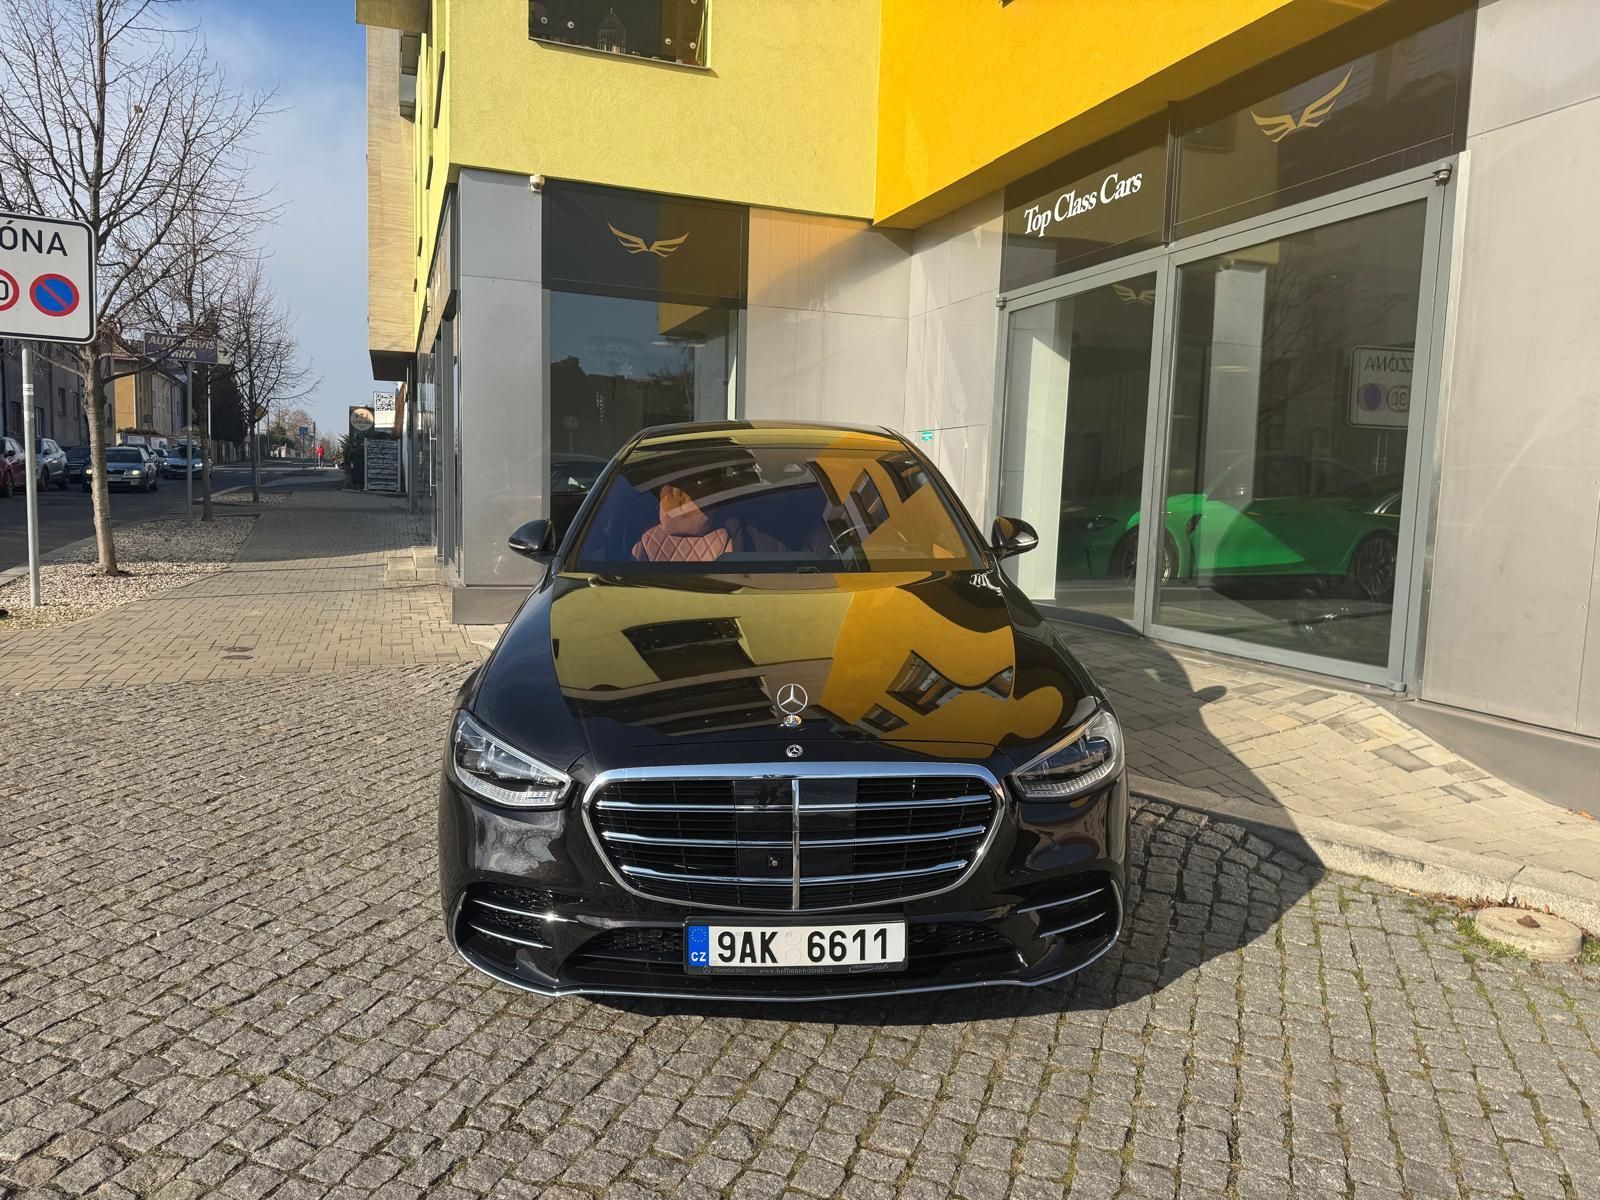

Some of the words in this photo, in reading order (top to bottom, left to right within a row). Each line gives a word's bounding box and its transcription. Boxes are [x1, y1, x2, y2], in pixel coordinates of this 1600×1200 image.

[1024, 204, 1051, 237] Top
[1054, 190, 1097, 221] Class
[1100, 172, 1142, 203] Cars
[691, 951, 706, 962] CZ
[717, 931, 778, 964] 9AK
[807, 928, 887, 963] 6611
